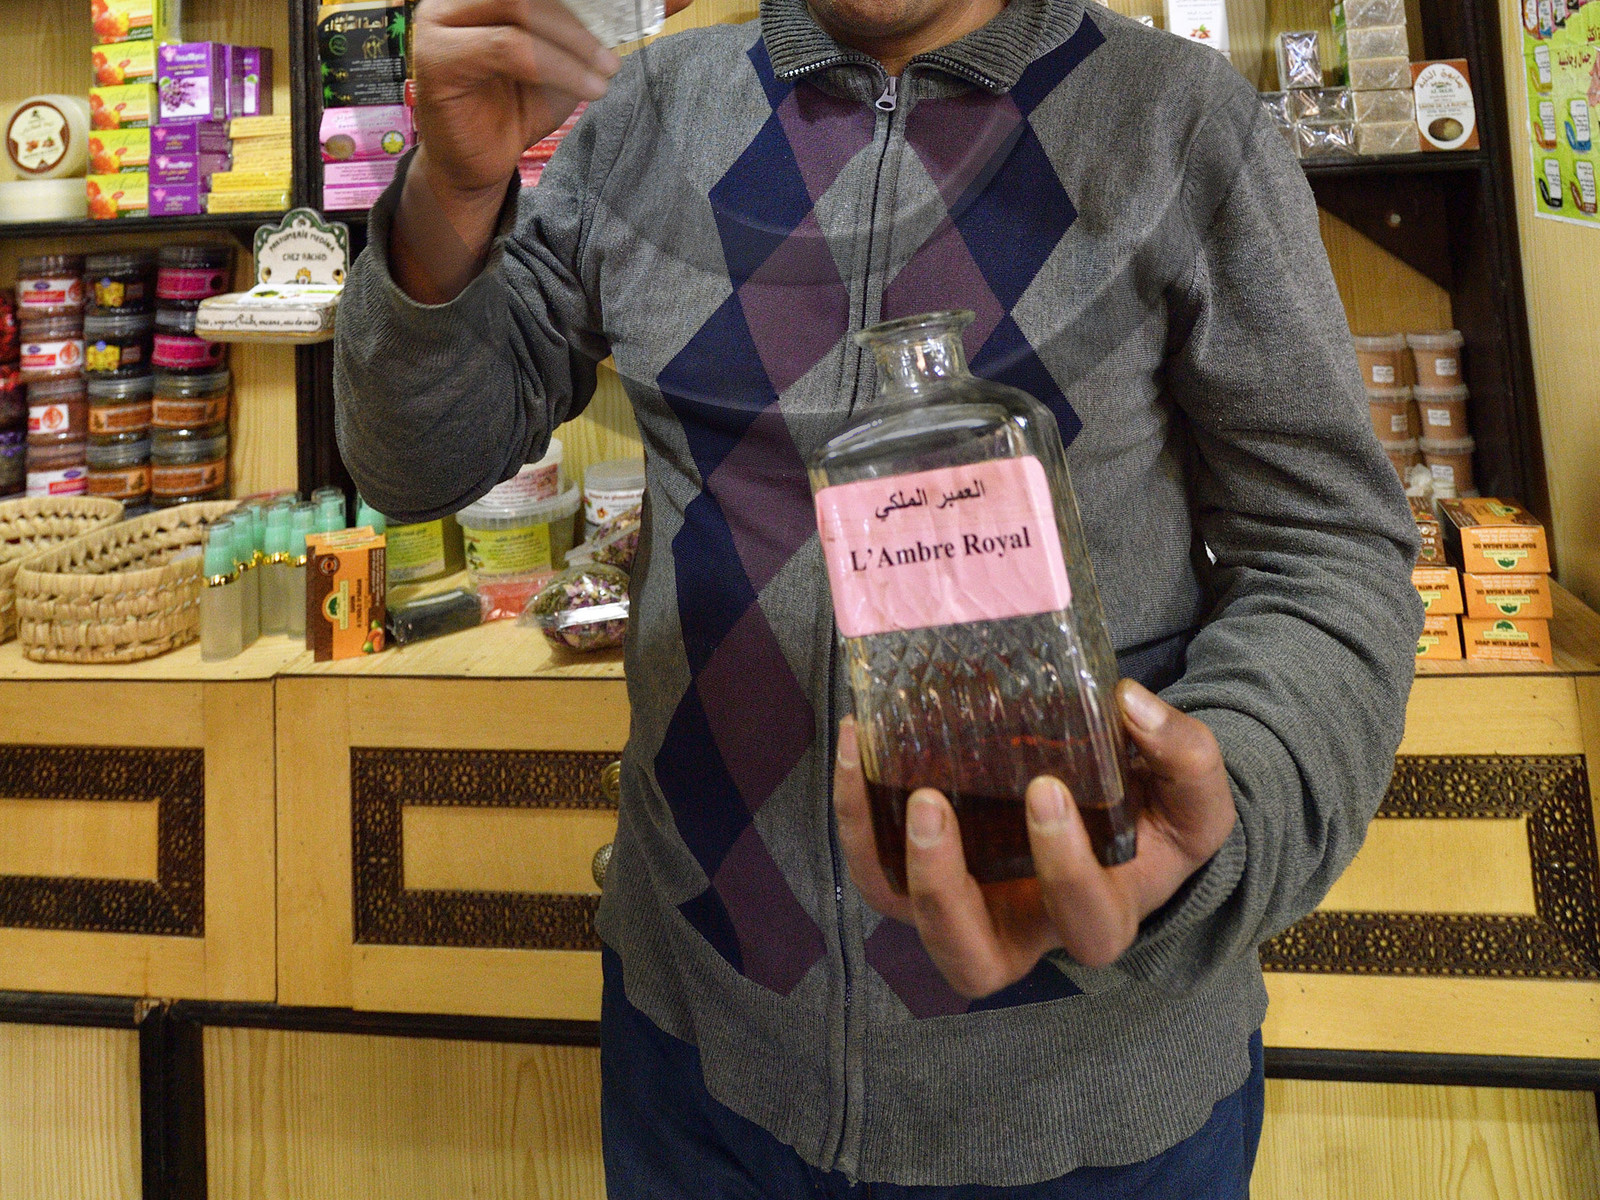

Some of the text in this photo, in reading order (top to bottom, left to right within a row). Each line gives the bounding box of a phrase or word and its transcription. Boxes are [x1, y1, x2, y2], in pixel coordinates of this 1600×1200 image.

[282, 253, 299, 261] CHEZ
[875, 489, 928, 520] الملكي
[850, 526, 1032, 572] L’Ambre Royal
